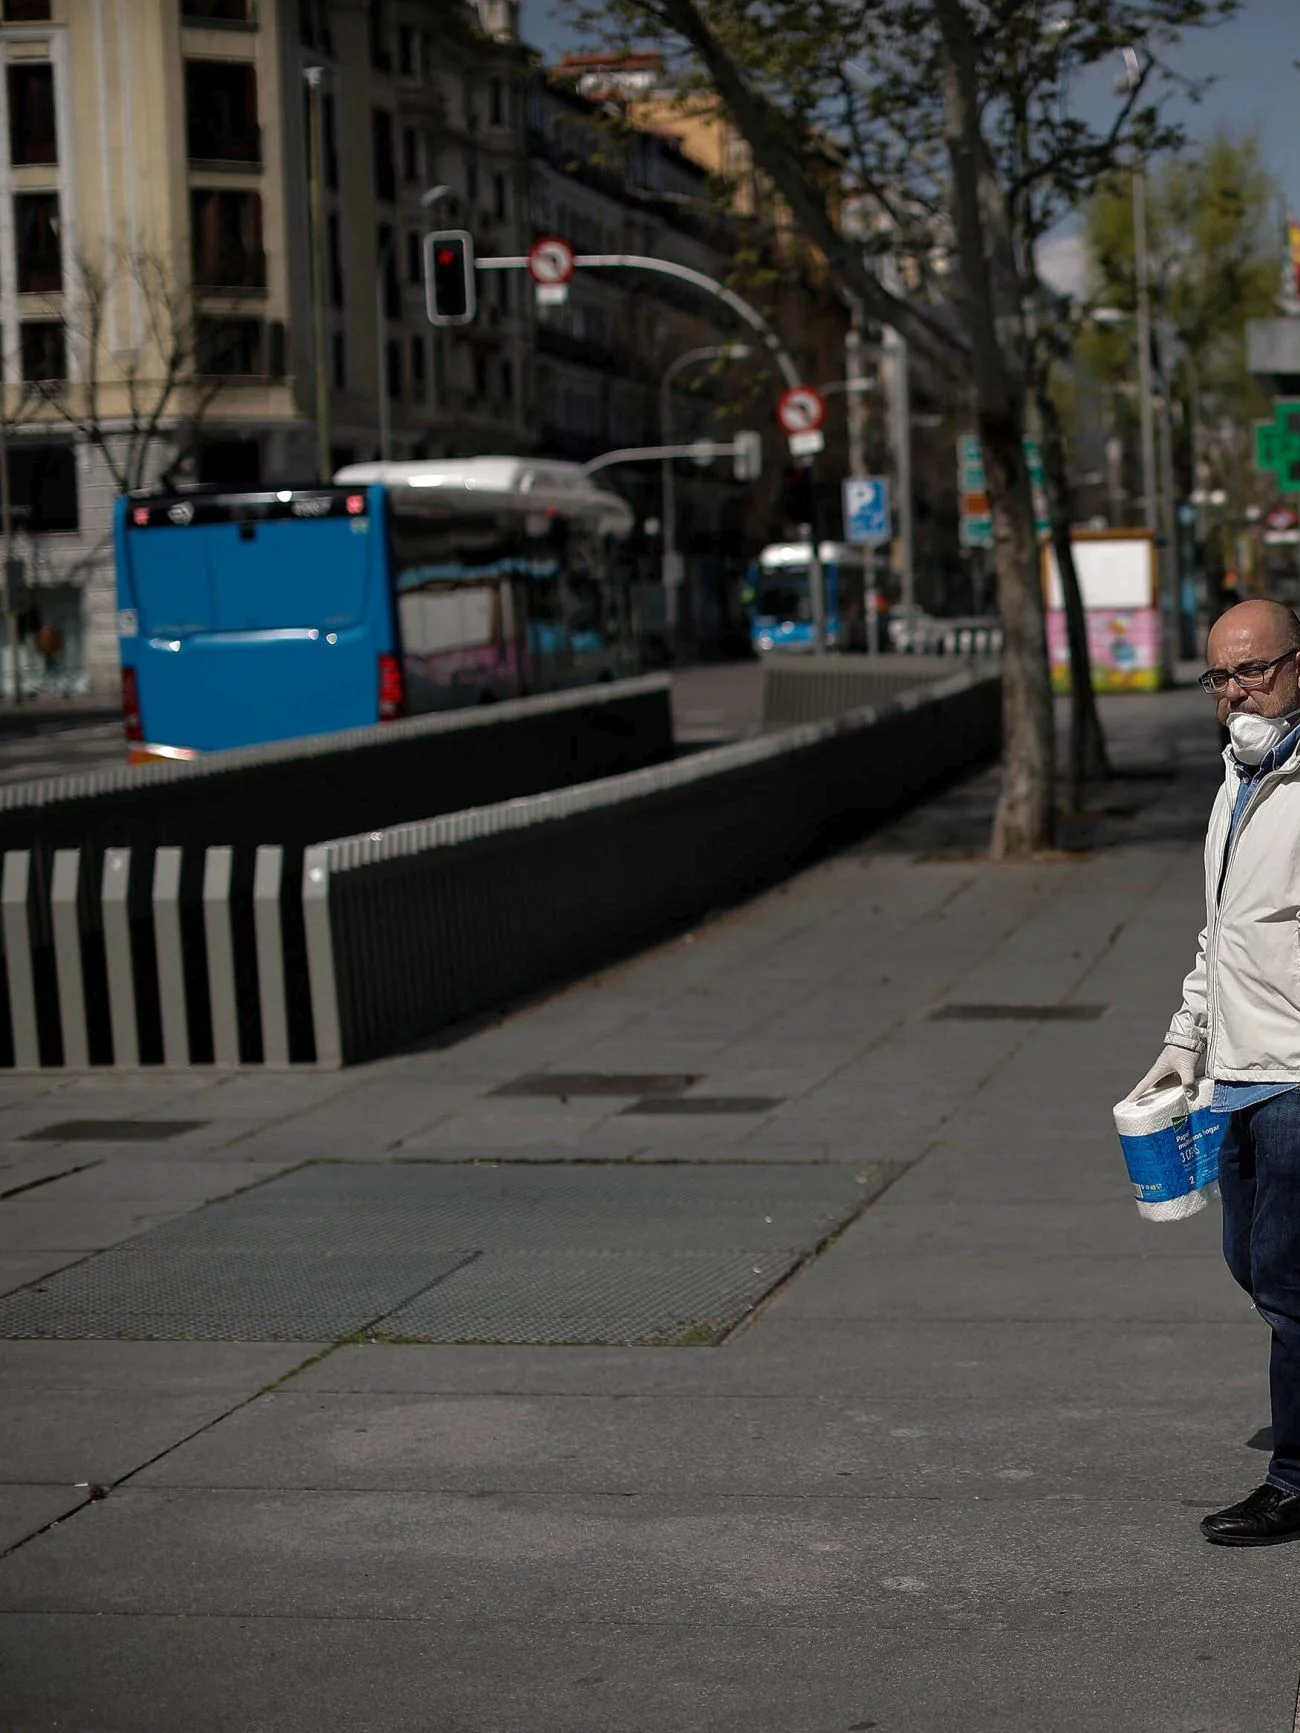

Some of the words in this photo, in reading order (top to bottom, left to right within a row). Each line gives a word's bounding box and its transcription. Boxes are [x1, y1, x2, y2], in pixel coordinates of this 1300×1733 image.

[1202, 1124, 1220, 1137] hogar
[1180, 1151, 1186, 1163] 3
[1189, 1175, 1195, 1185] 2
